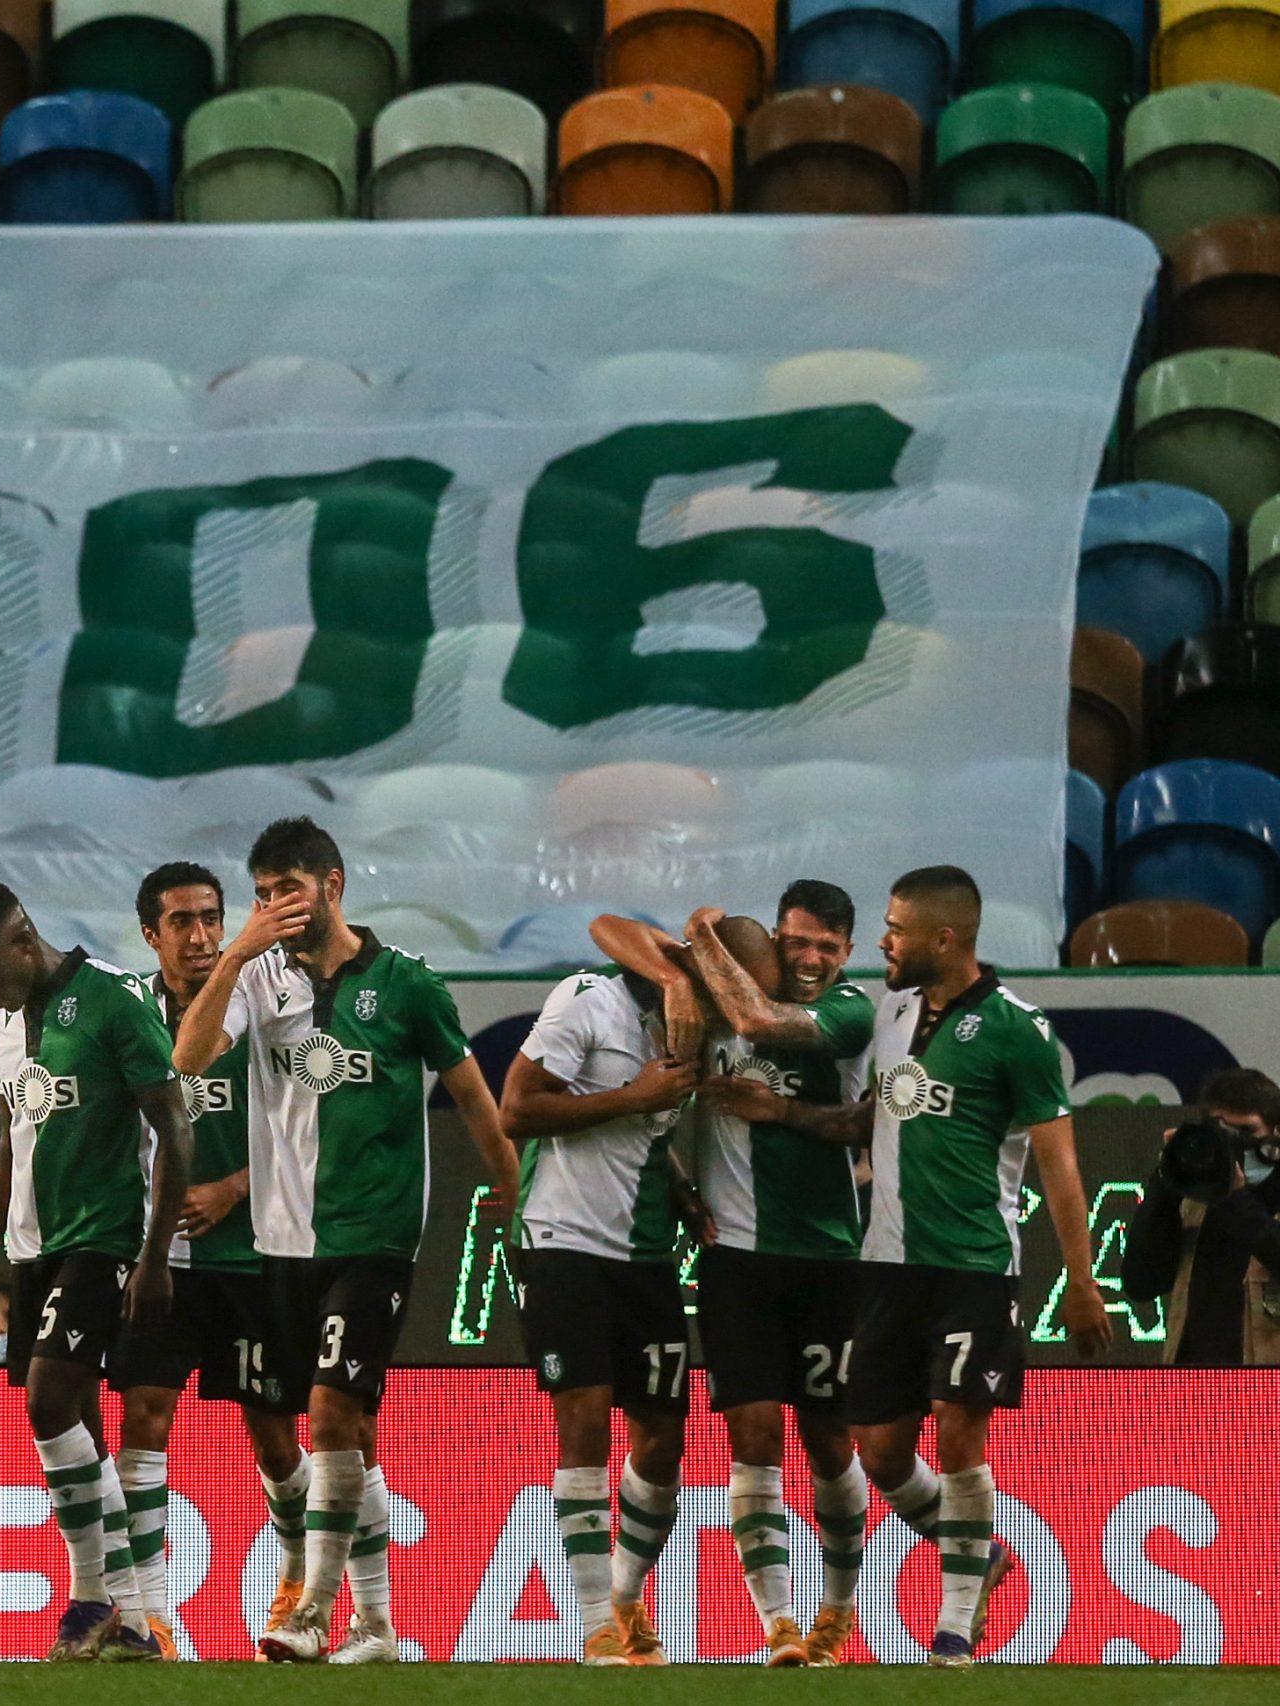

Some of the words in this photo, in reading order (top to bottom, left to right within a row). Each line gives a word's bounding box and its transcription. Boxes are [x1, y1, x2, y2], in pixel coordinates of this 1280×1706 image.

[318, 1315, 345, 1368] 3
[945, 1332, 973, 1386] 7
[643, 1342, 687, 1397] 17
